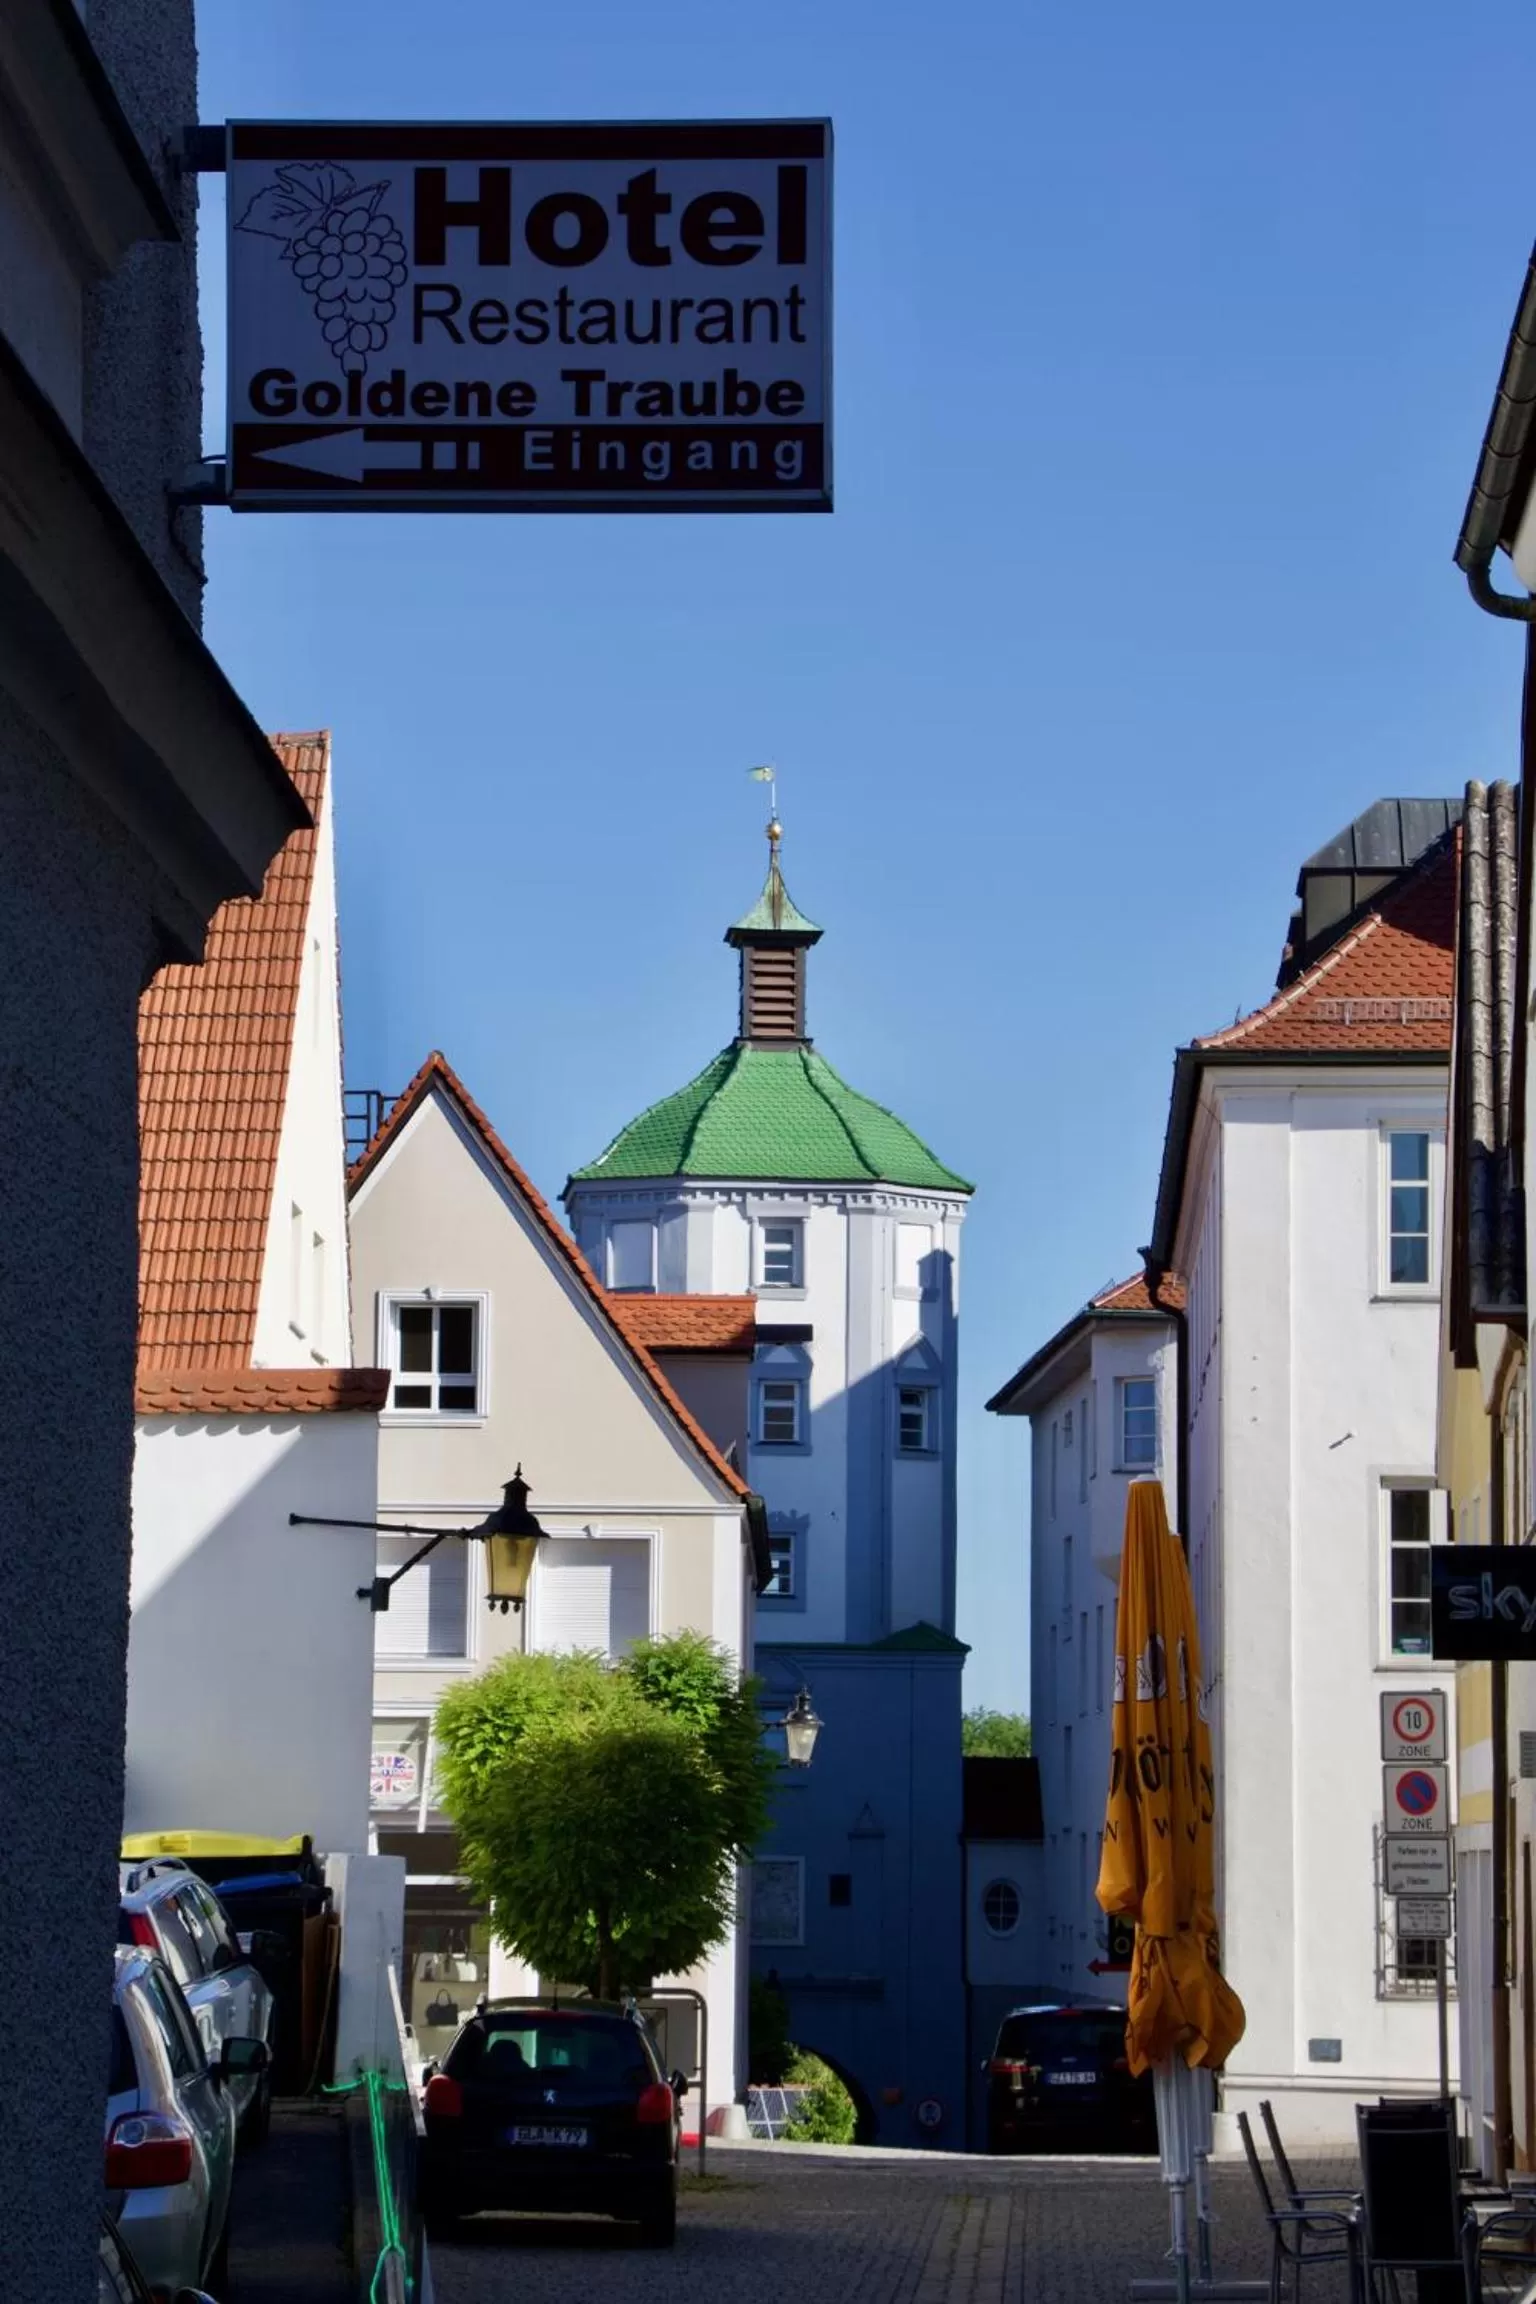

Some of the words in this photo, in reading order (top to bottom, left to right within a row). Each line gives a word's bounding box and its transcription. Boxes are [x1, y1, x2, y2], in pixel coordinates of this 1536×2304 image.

[413, 165, 808, 268] Hotel
[412, 283, 807, 345] Restaurant
[248, 368, 538, 418] Goldene
[561, 368, 805, 418] Traube
[523, 430, 804, 482] Eingang
[1448, 1571, 1536, 1633] sky
[1405, 1711, 1422, 1729] 10
[1398, 1745, 1432, 1757] ZONE
[1401, 1817, 1433, 1830] ZONE
